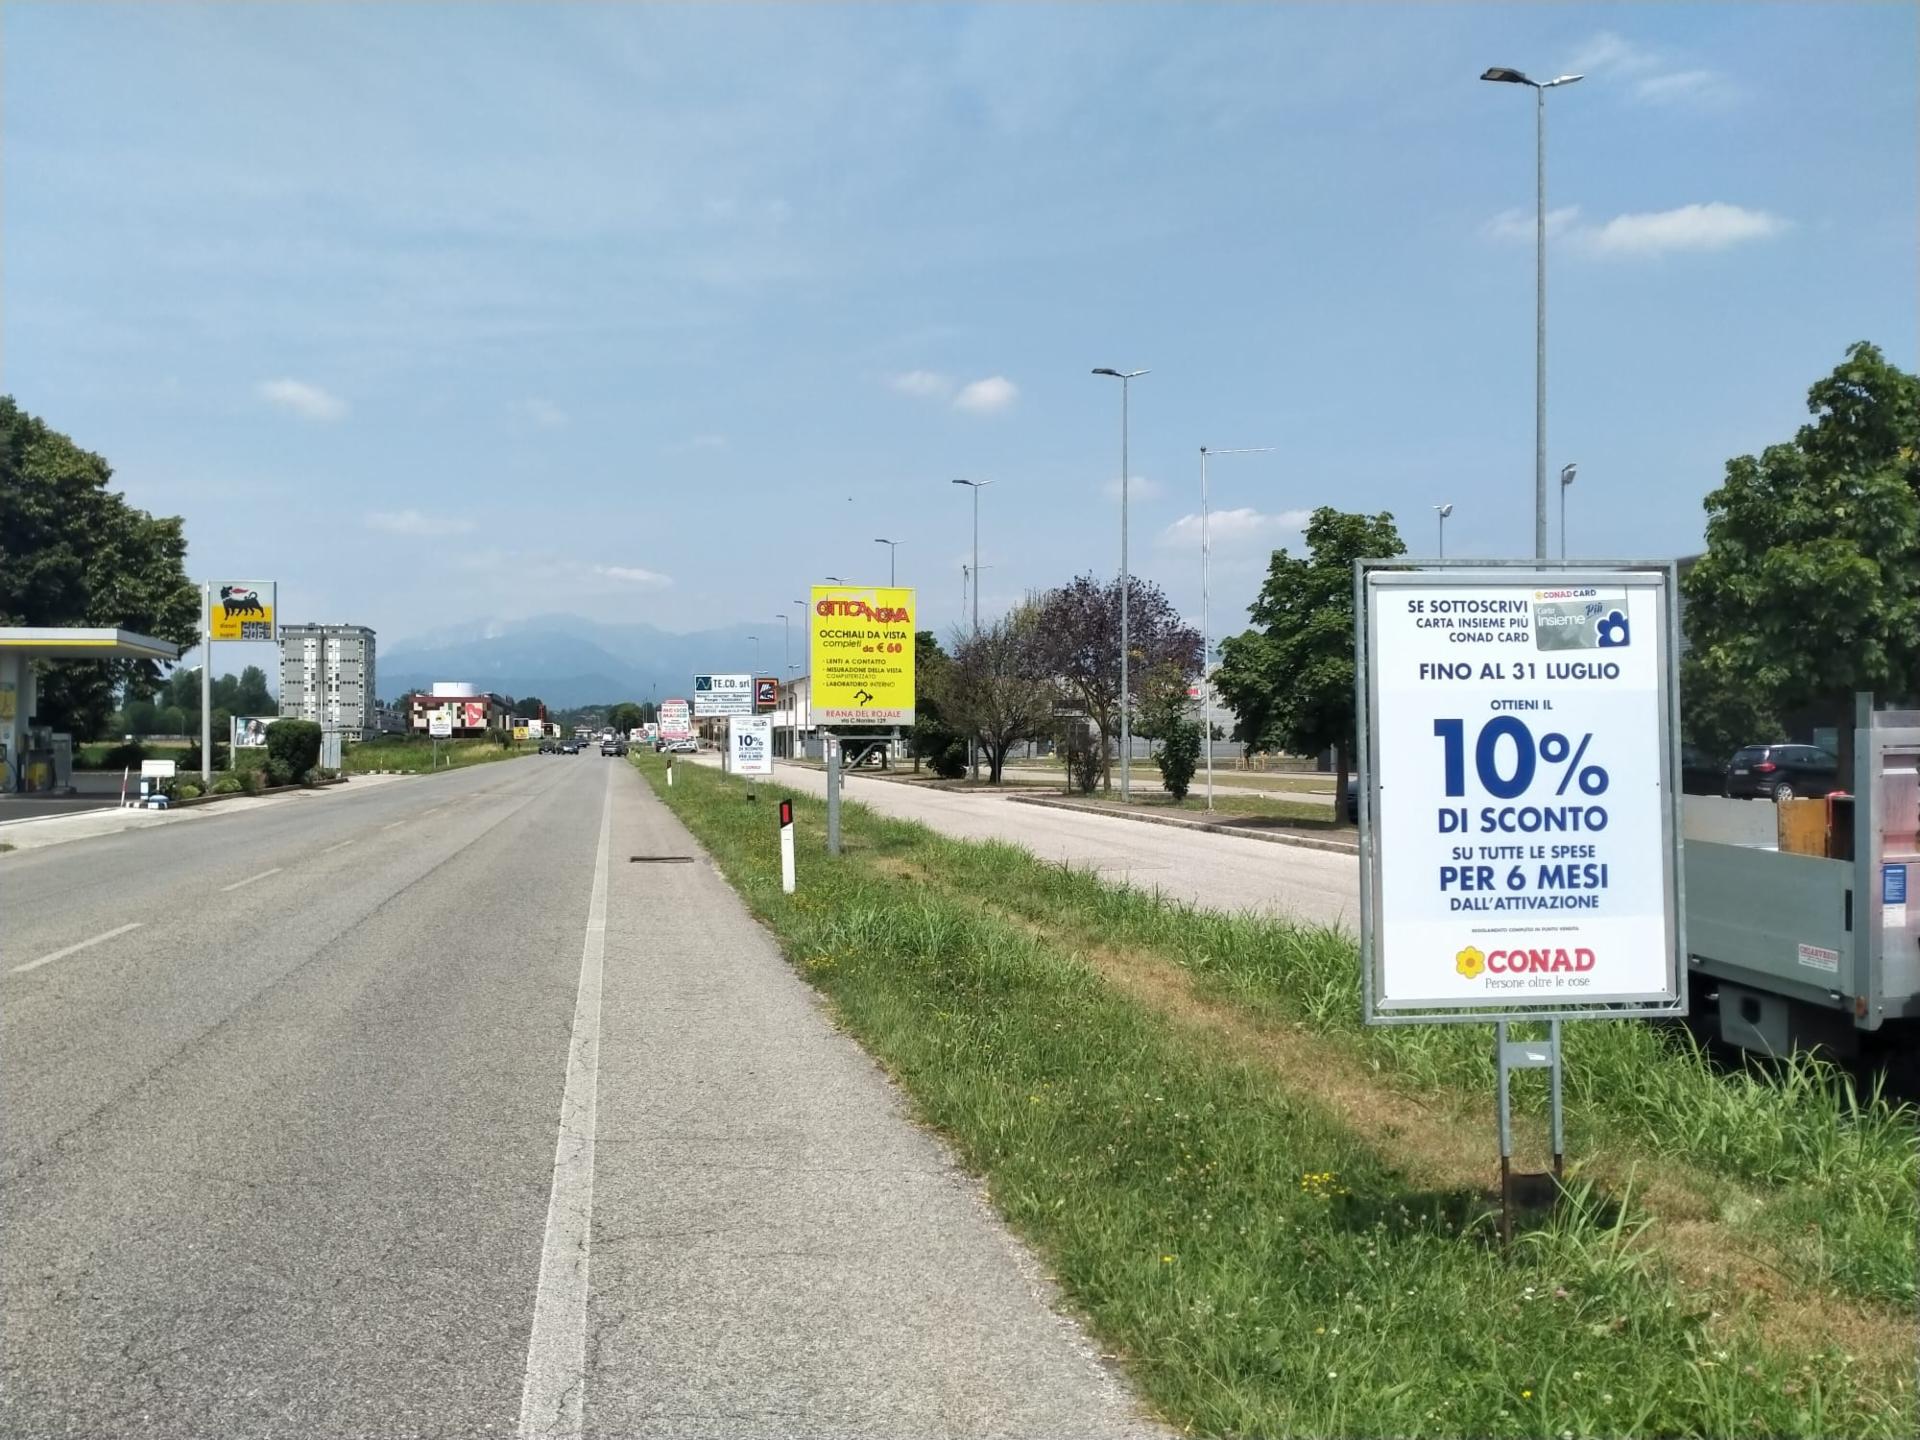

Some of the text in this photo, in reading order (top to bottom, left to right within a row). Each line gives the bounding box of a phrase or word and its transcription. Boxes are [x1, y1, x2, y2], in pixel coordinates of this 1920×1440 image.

[1408, 600, 1528, 613] SE SOTTOSCRIVI
[1416, 614, 1528, 628] CARTA INSIEME PIÙ
[820, 630, 864, 638] OCCHIALI
[1449, 632, 1529, 642] CONAD CARD
[862, 645, 874, 653] da
[876, 643, 884, 652] €
[1420, 662, 1620, 680] FINO AL 31 LUGLIO
[1490, 700, 1553, 710] OTTIENI IL
[738, 734, 764, 746] 10%
[1434, 715, 1609, 799] 10%
[1438, 806, 1608, 833] DI SCONTO
[1452, 845, 1596, 860] SU TUTTE LE SPESE
[1440, 864, 1608, 891] PER 6 MESI
[1450, 896, 1598, 911] DALL'ATTIVAZIONE
[1488, 948, 1596, 974] CONAD
[1485, 976, 1590, 988] Persone oltre le cose
